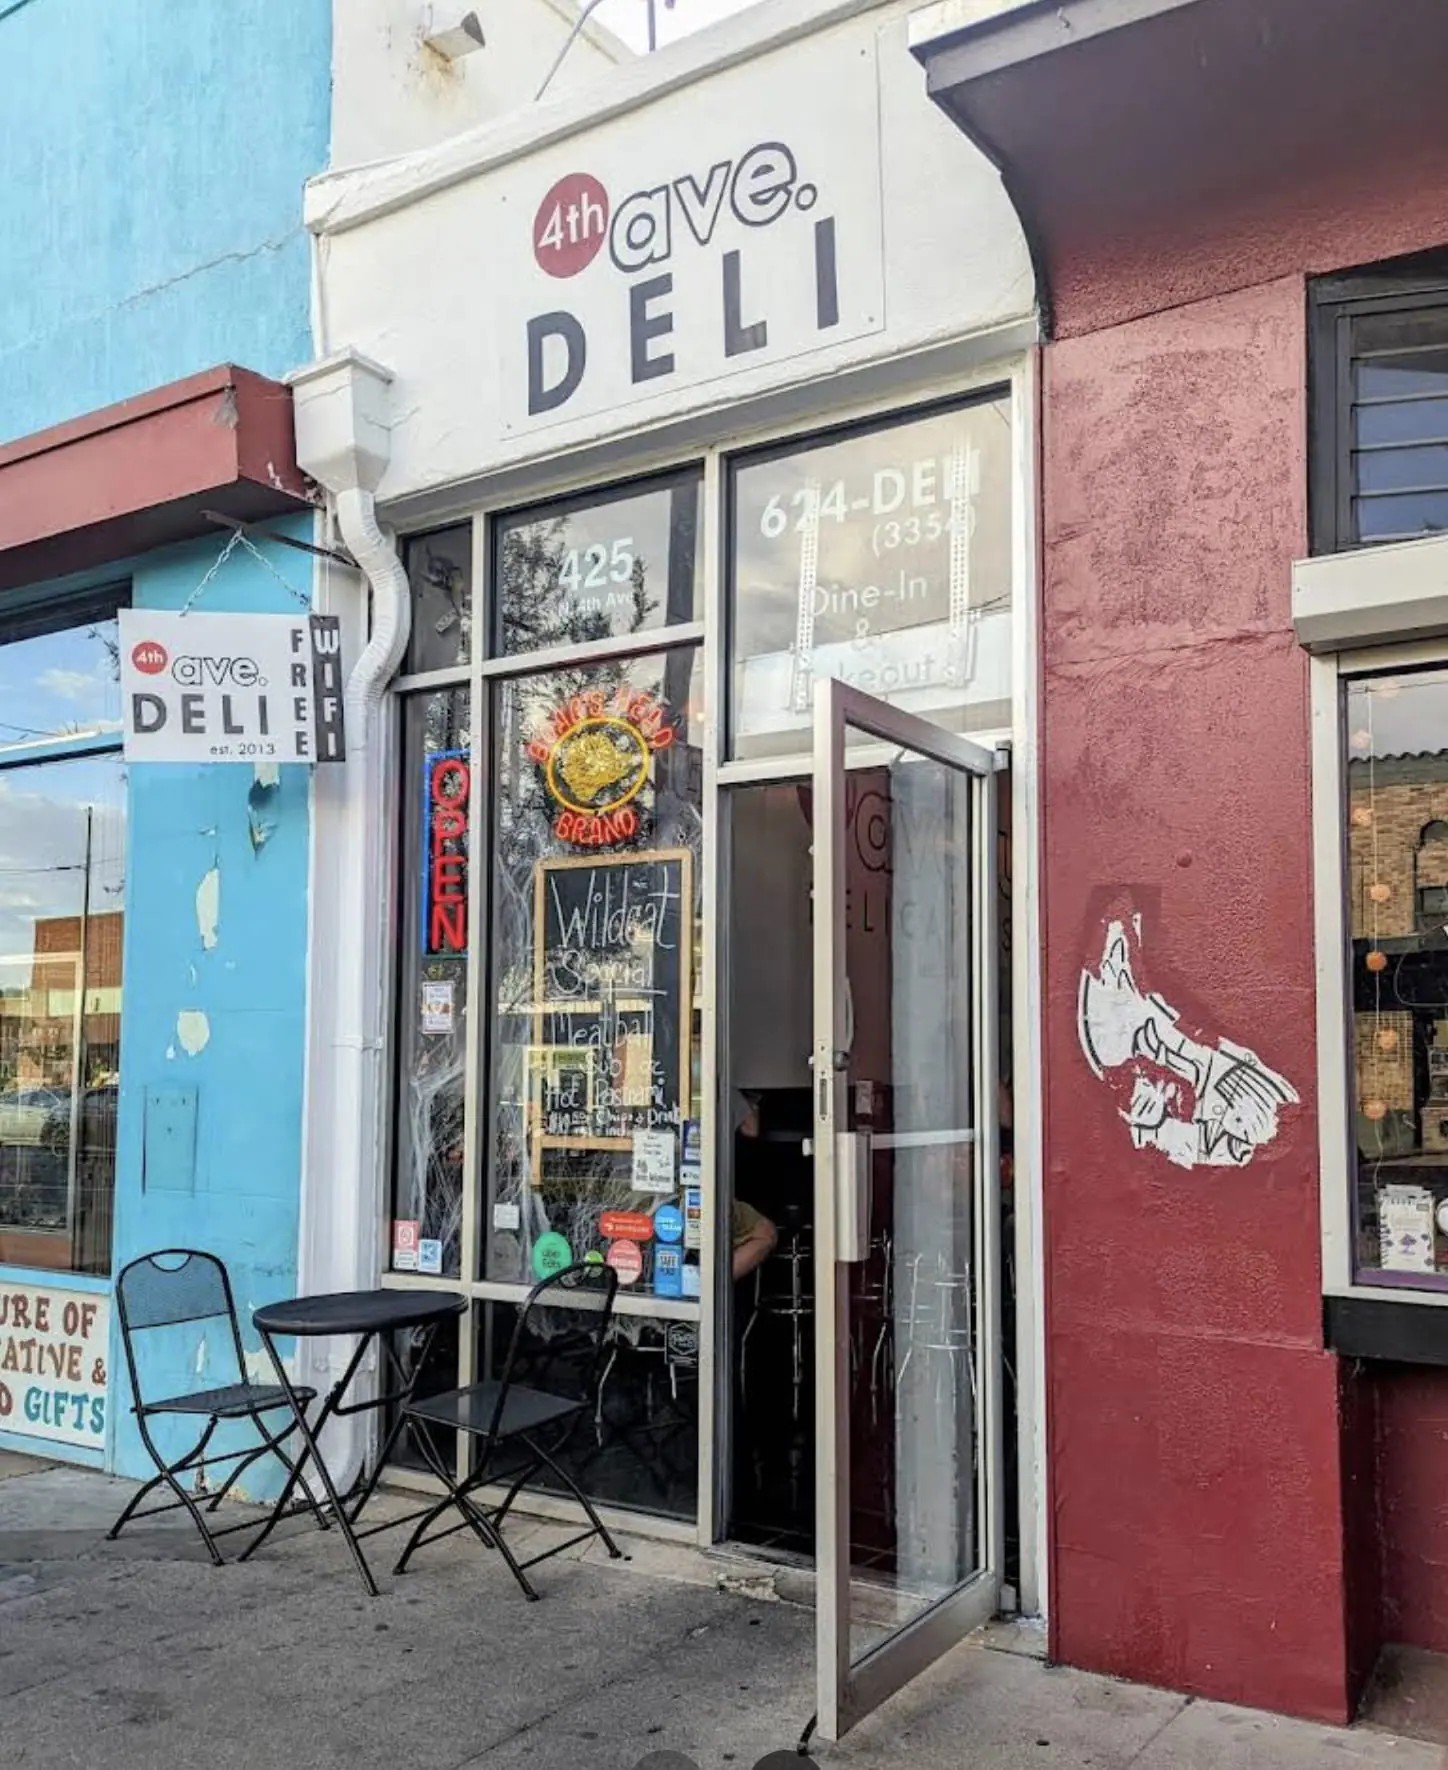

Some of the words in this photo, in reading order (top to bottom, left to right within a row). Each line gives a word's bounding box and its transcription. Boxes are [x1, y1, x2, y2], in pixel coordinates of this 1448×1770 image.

[538, 192, 605, 250] 4th
[609, 141, 818, 273] ave.
[526, 215, 839, 416] DELI
[558, 537, 634, 590] 425
[808, 569, 927, 616] Dine-In
[135, 650, 165, 665] 4th
[172, 655, 269, 687] ave.
[290, 628, 309, 756] FREE
[313, 628, 339, 757] WIFI
[132, 692, 269, 735] DELI
[209, 744, 233, 755] est.
[238, 743, 276, 756] 2013
[555, 807, 638, 846] BRAND
[431, 759, 470, 952] OPEN
[551, 866, 681, 950] Wildcat
[63, 1301, 98, 1339] OF
[92, 1357, 106, 1385] &
[24, 1386, 106, 1434] GIFTS
